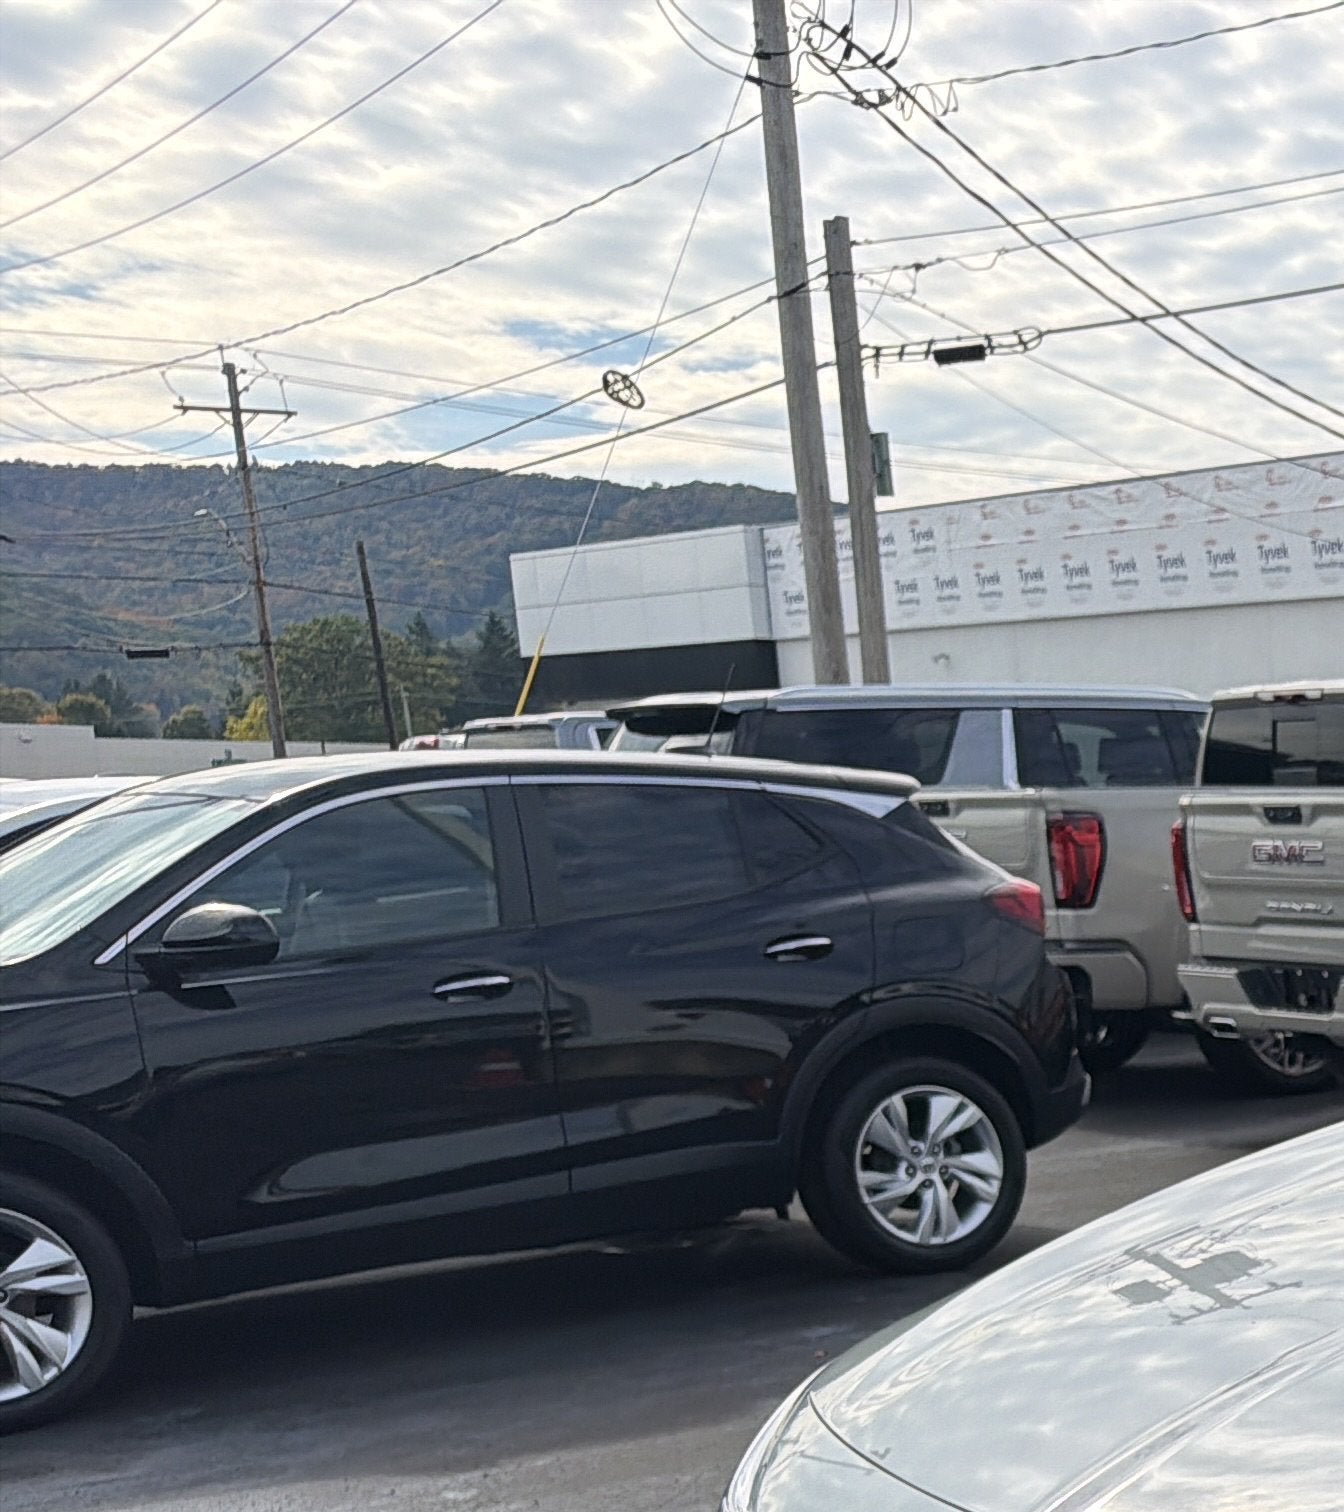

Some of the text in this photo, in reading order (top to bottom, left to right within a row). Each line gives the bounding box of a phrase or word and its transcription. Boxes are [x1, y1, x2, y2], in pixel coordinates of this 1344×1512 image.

[1206, 547, 1236, 568] Tyvek
[1257, 543, 1289, 564] Tyvek
[1310, 538, 1344, 560] Tyvek
[1156, 552, 1186, 573] Tyvek
[1252, 839, 1325, 864] GMC
